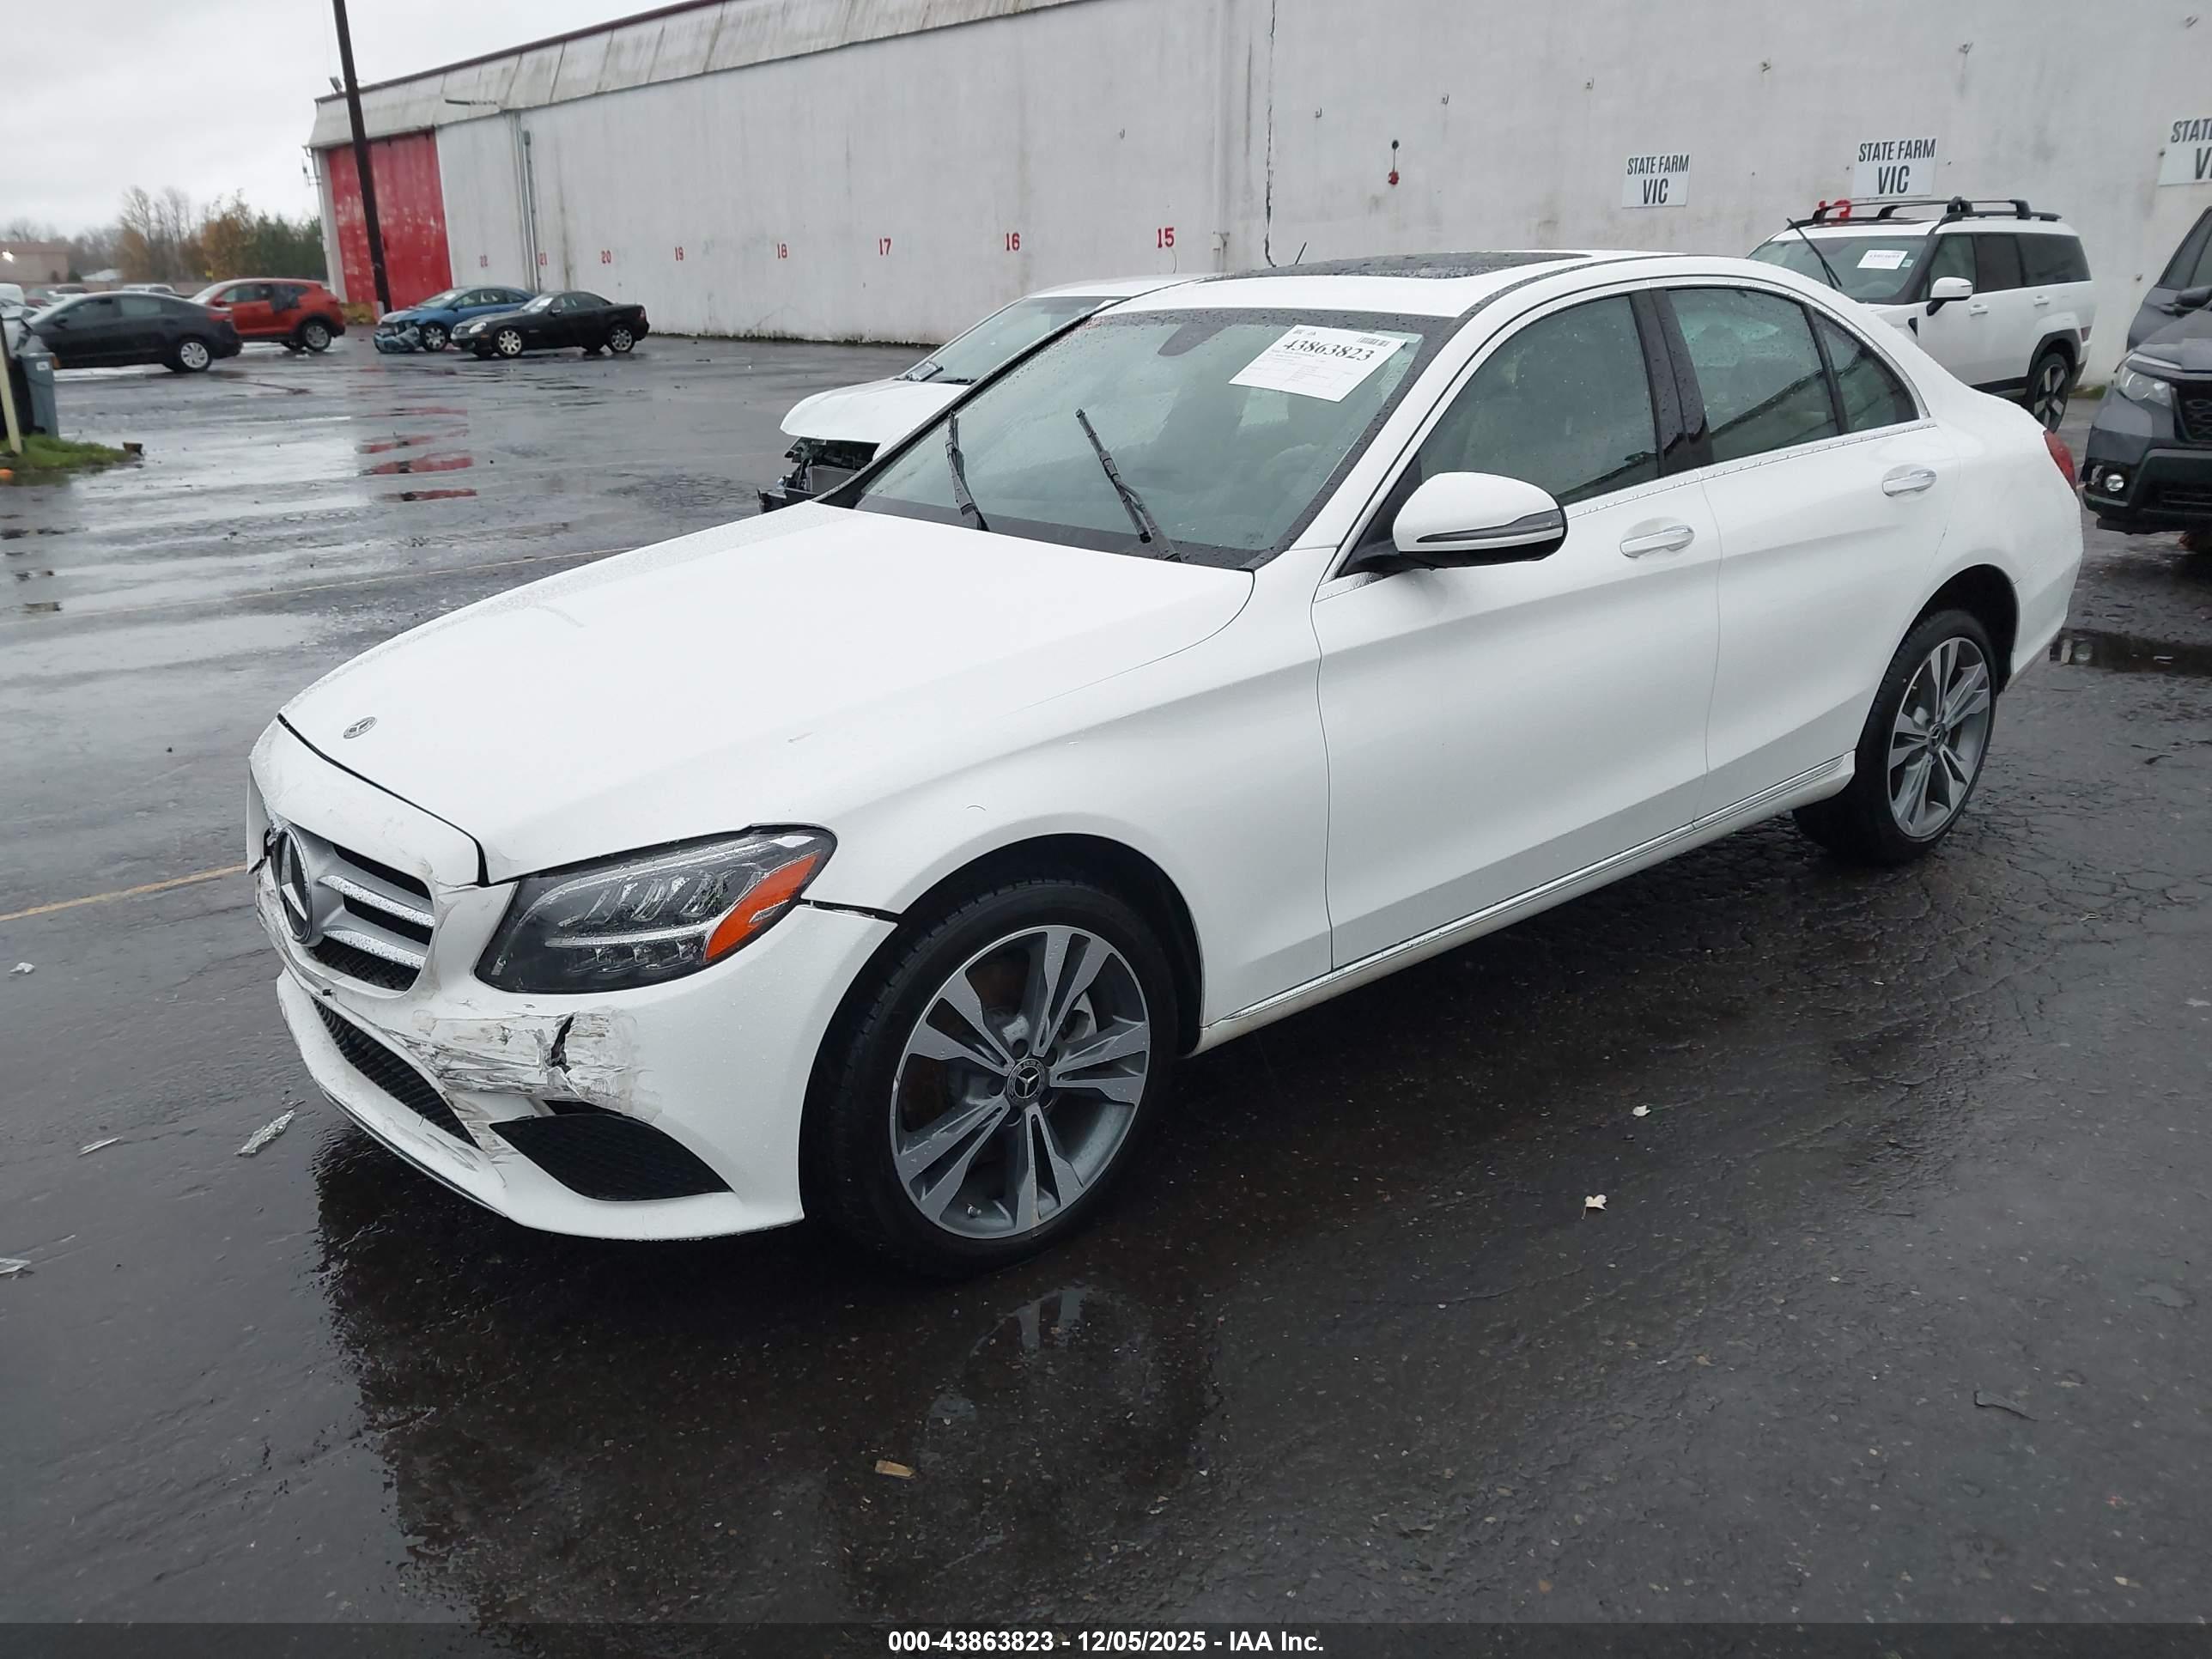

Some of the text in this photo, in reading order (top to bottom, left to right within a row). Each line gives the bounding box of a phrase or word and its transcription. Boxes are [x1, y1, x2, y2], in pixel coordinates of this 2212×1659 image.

[1858, 138, 1936, 162] STATE FARM
[1627, 155, 1689, 175] STATE FARM
[2195, 147, 2212, 179] V
[1878, 165, 1911, 195] VIC
[1643, 178, 1668, 204] VIC
[878, 238, 891, 256] 17
[1006, 233, 1020, 252] 16
[1157, 227, 1176, 248] 15
[601, 250, 611, 264] 20
[777, 243, 787, 259] 18
[1284, 339, 1375, 362] 43863823
